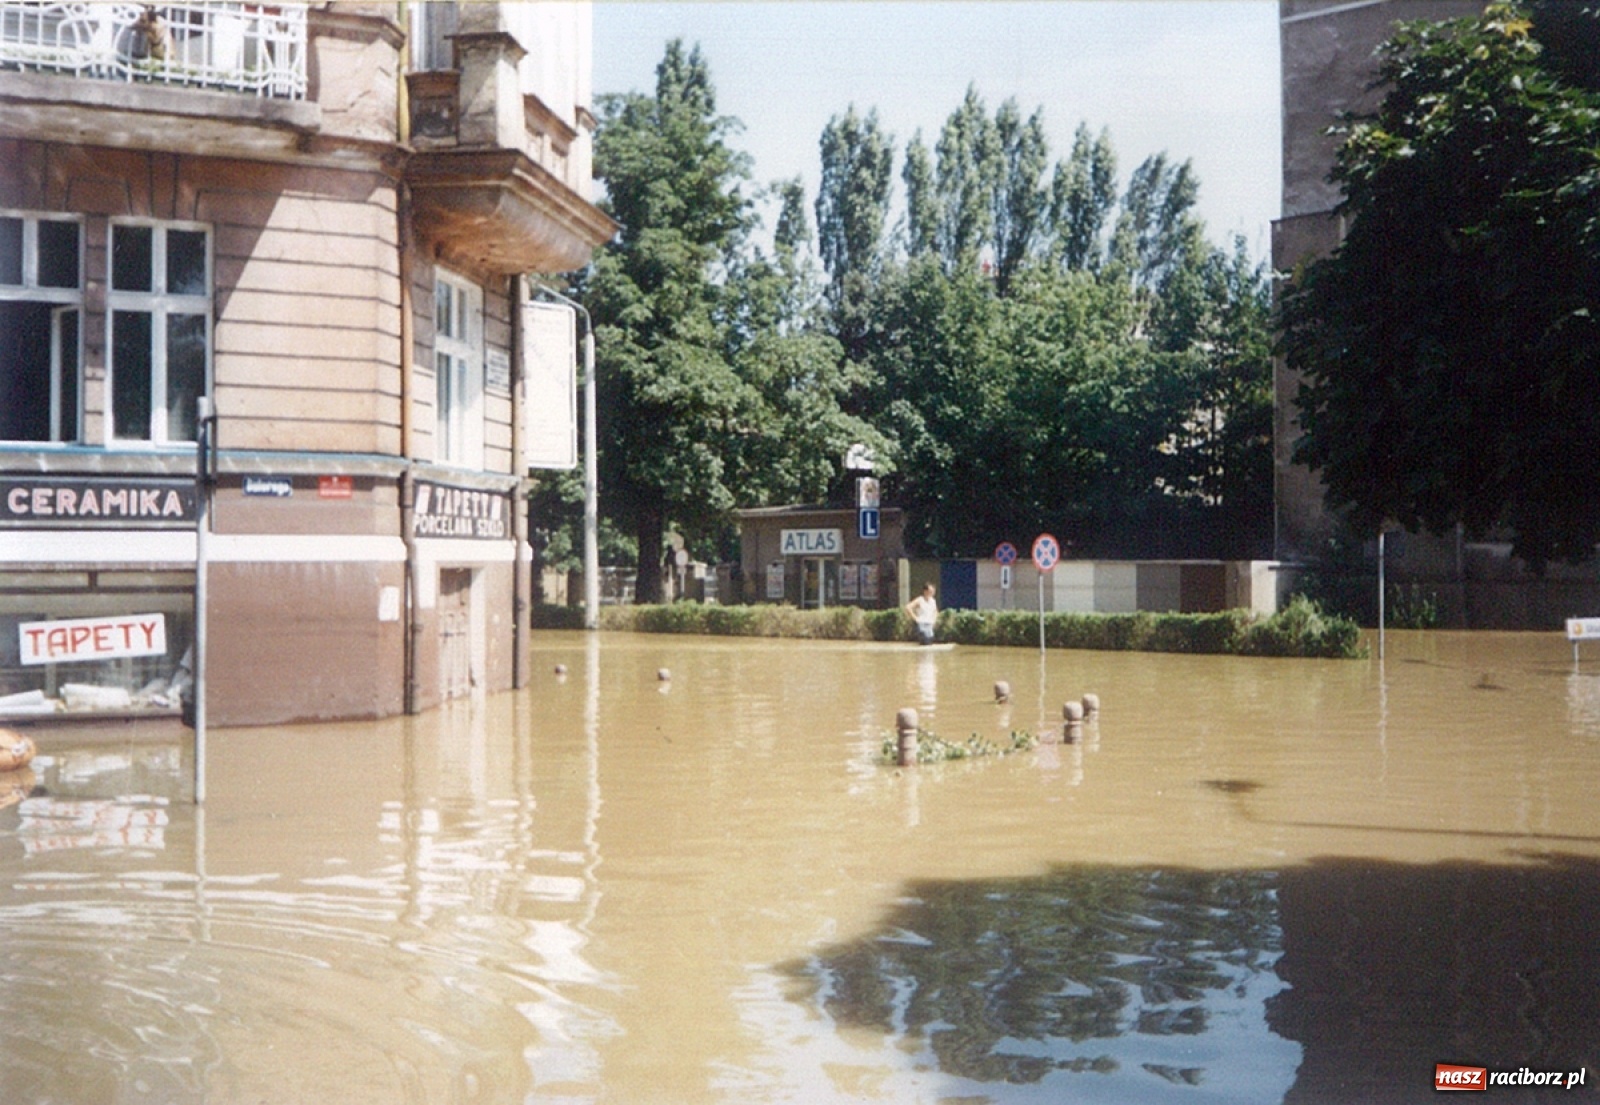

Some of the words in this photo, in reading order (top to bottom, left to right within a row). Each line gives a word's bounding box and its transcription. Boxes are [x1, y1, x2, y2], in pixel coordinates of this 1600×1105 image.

[7, 487, 183, 516] CERAMIKA
[436, 487, 489, 517] TAPETY
[866, 512, 876, 535] L
[784, 532, 836, 551] ATLAS
[25, 621, 157, 657] TAPETY
